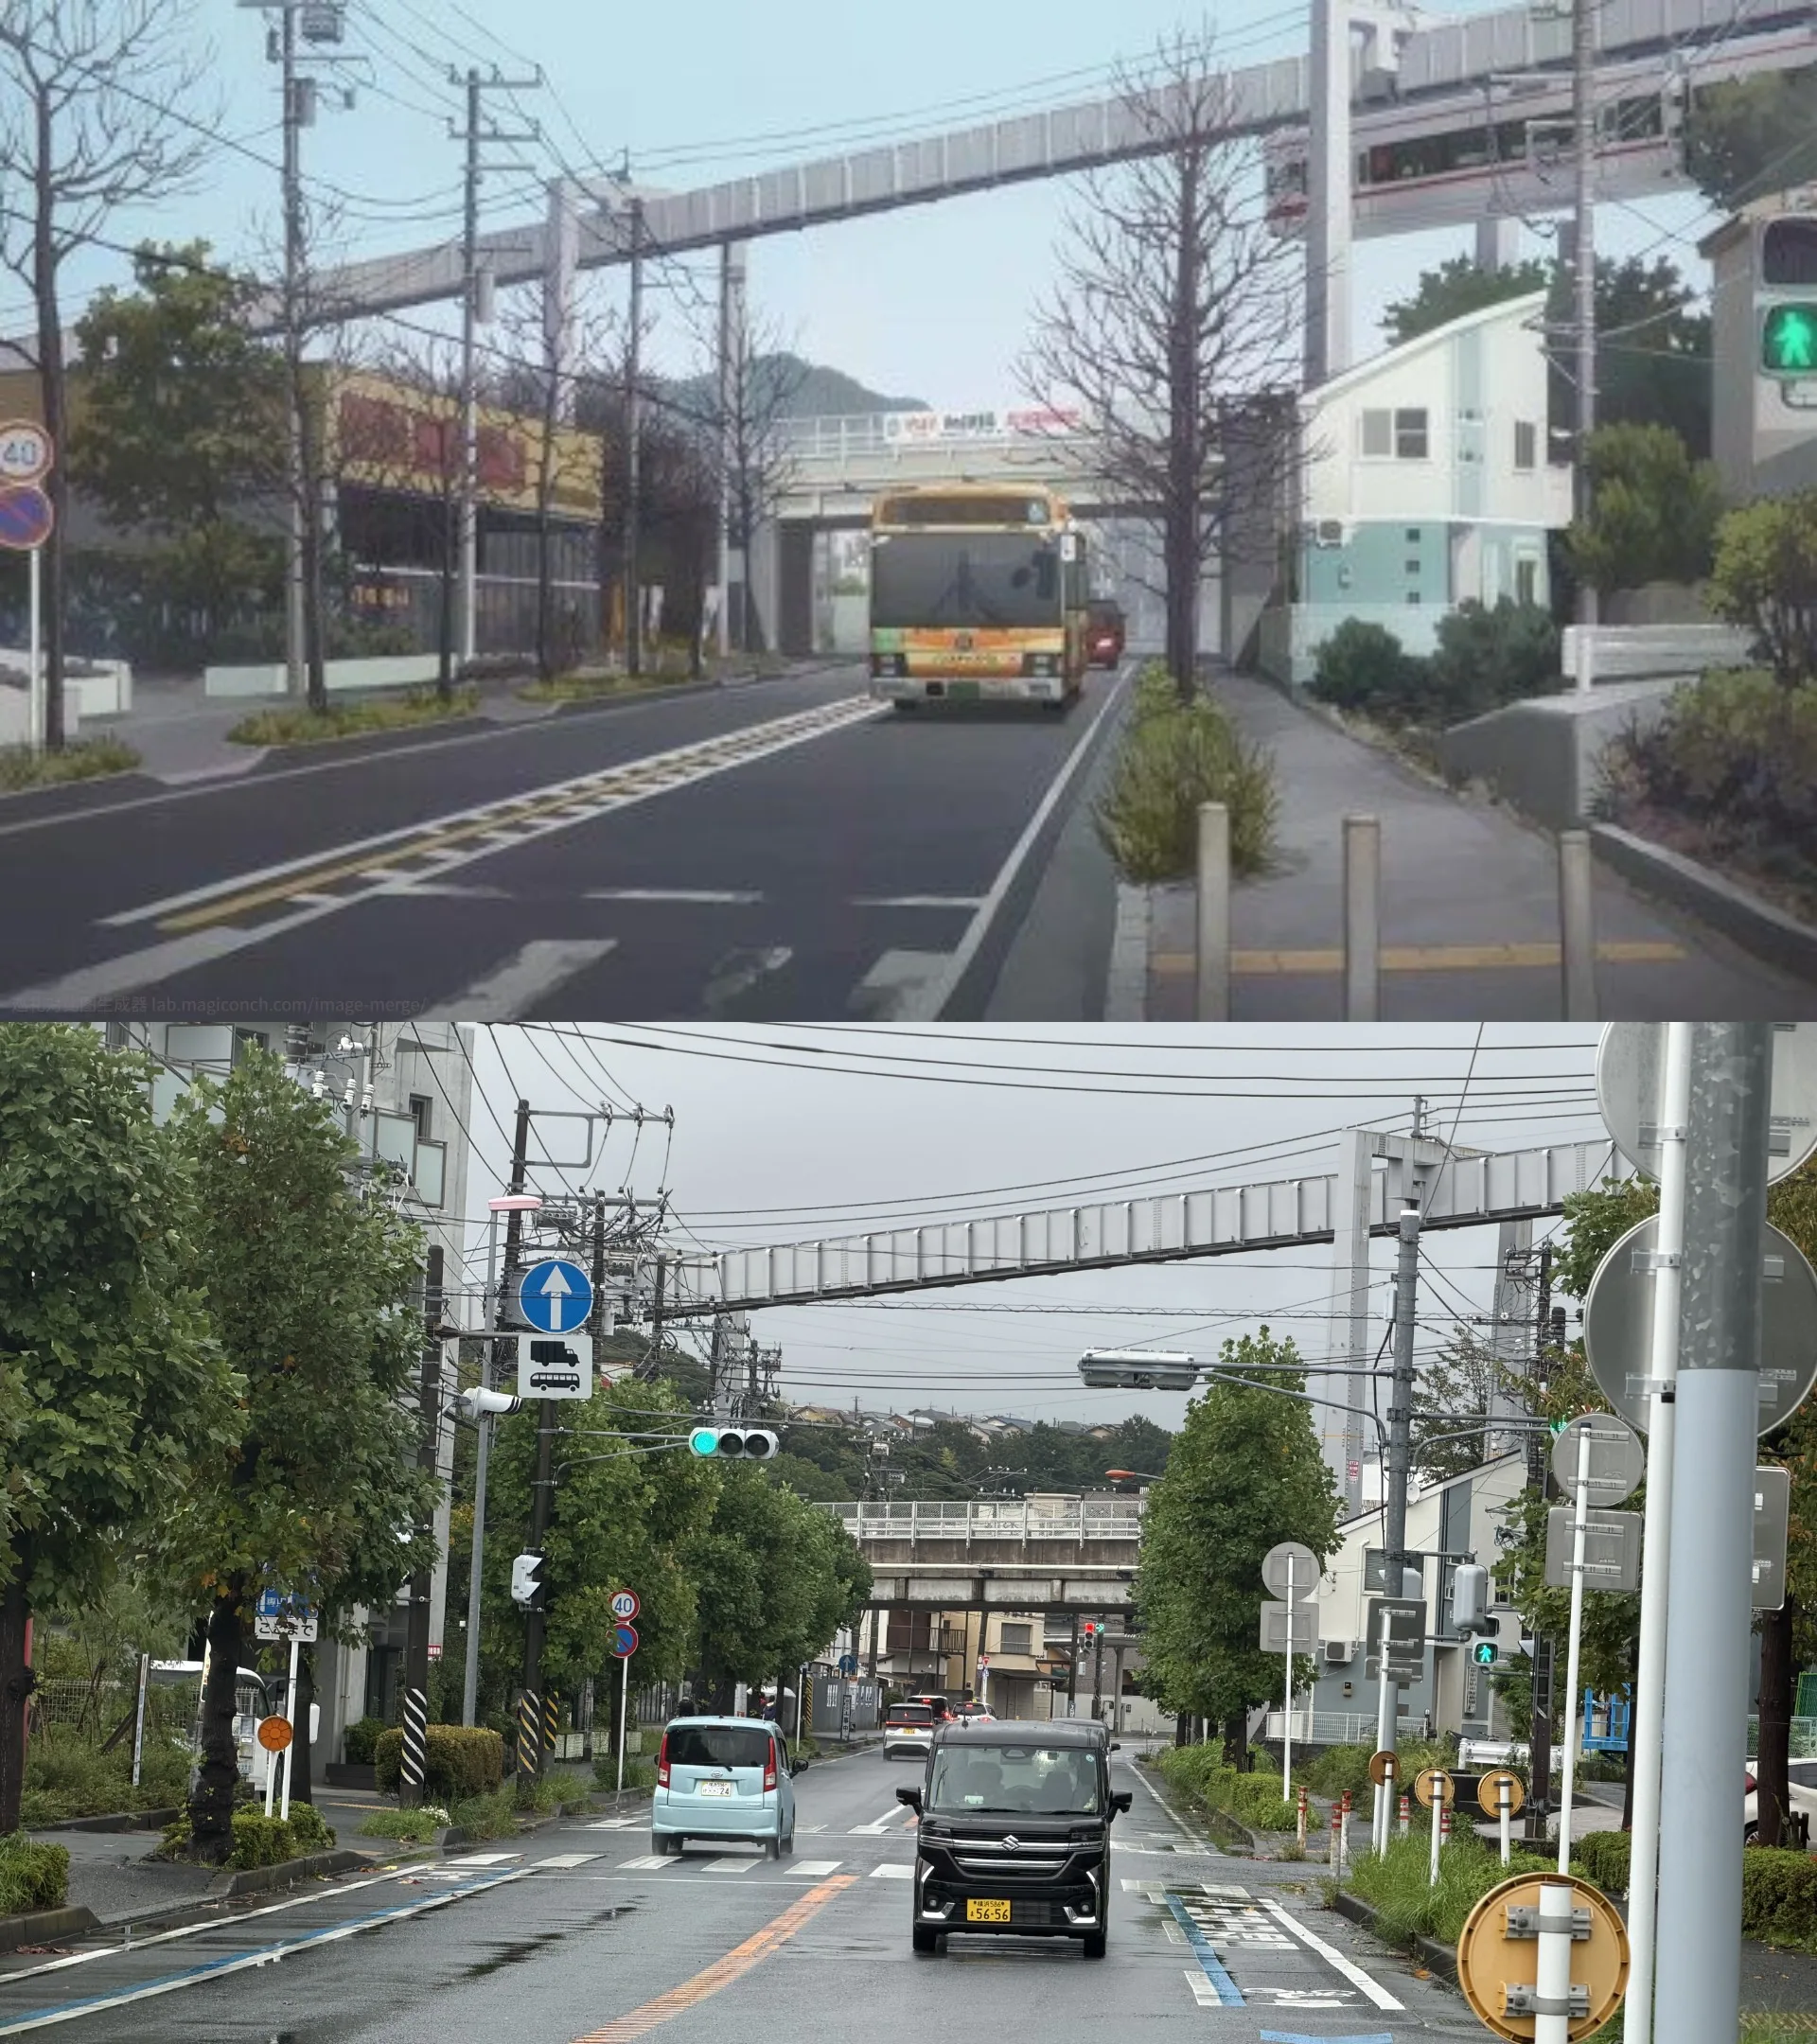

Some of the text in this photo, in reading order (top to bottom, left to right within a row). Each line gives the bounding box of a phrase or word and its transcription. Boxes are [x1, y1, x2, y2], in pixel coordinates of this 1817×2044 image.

[3, 440, 36, 465] 40
[614, 1597, 632, 1612] 40
[977, 1908, 1009, 1920] 56-56
